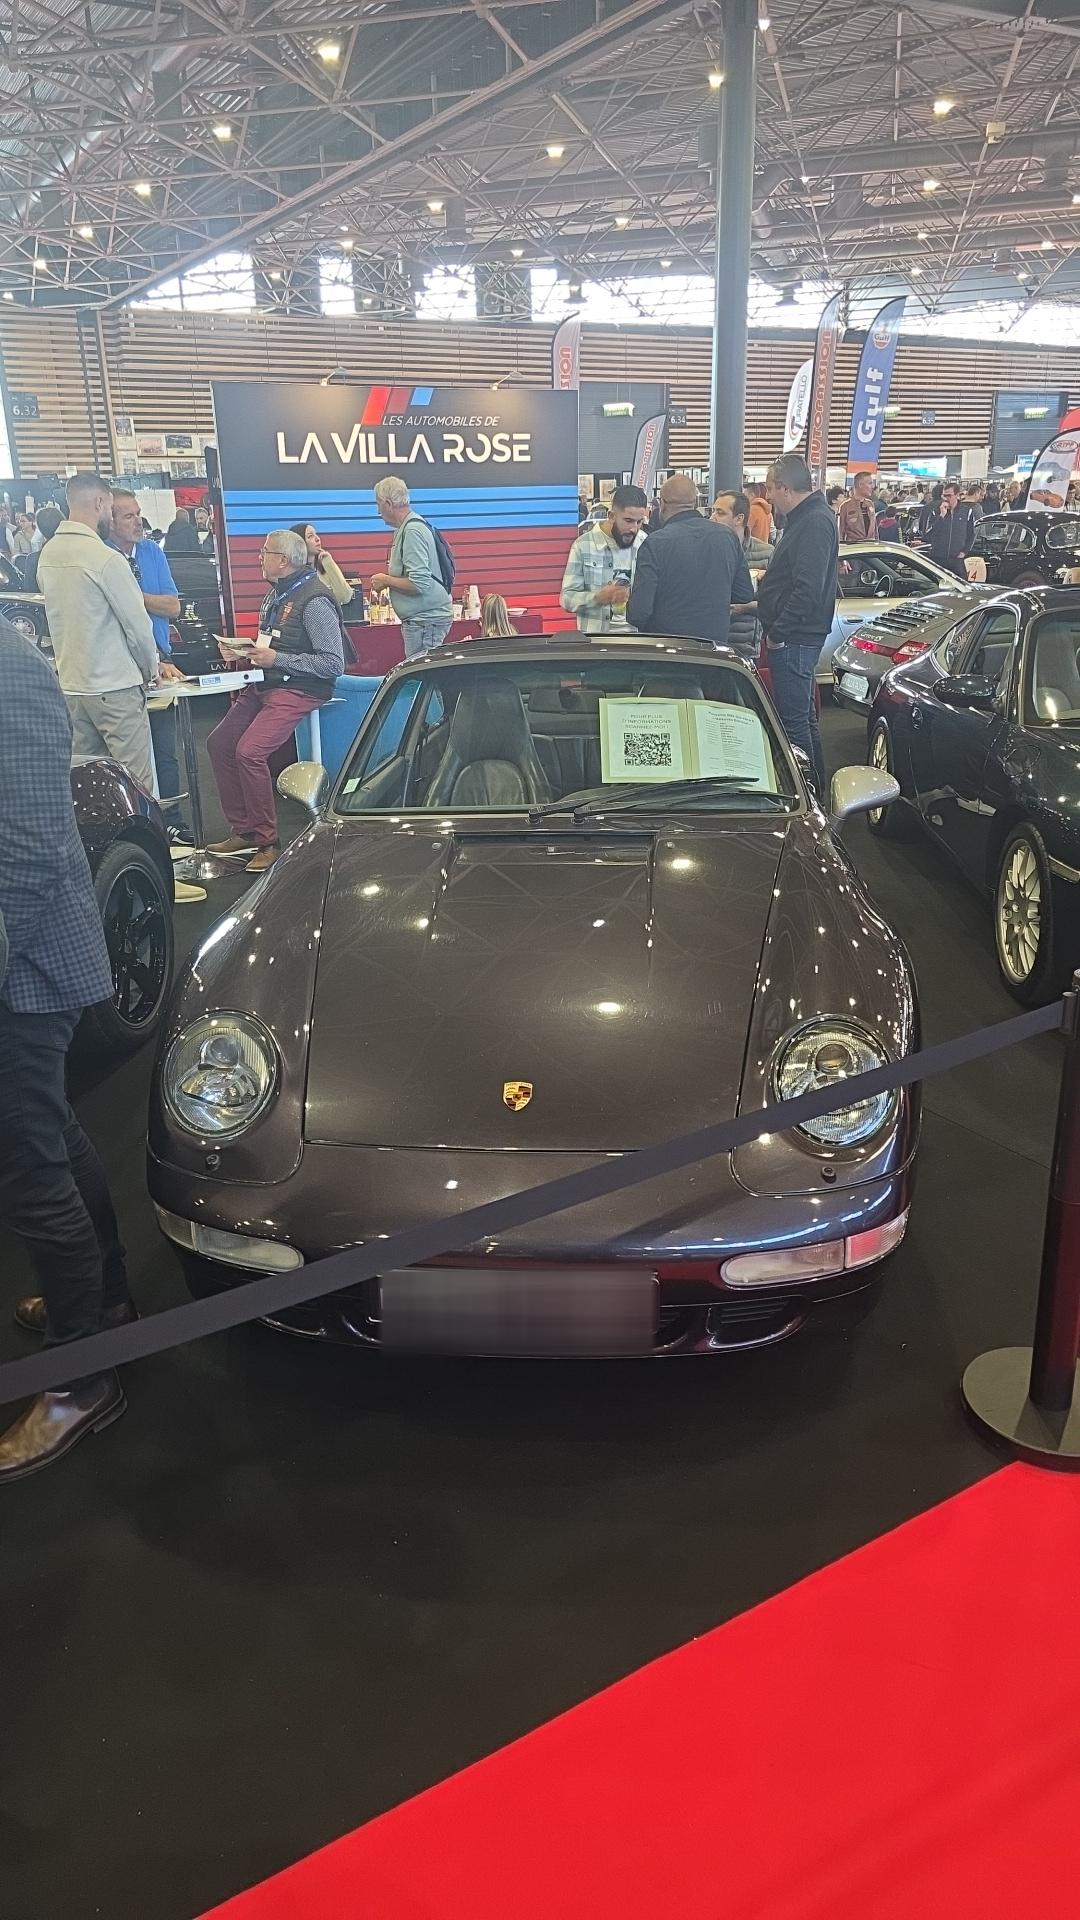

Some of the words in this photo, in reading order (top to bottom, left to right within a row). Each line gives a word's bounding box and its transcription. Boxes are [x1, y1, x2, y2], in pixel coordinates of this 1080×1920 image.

[874, 333, 891, 344] Gulf
[13, 405, 38, 416] 6.32
[857, 367, 884, 443] Gulf
[382, 416, 403, 426] LES
[405, 416, 482, 426] AUTOMOBILES
[484, 416, 500, 427] DE
[671, 415, 686, 424] 6.34
[277, 432, 328, 463] LA
[330, 424, 435, 464] VILLA
[443, 433, 532, 464] ROSE
